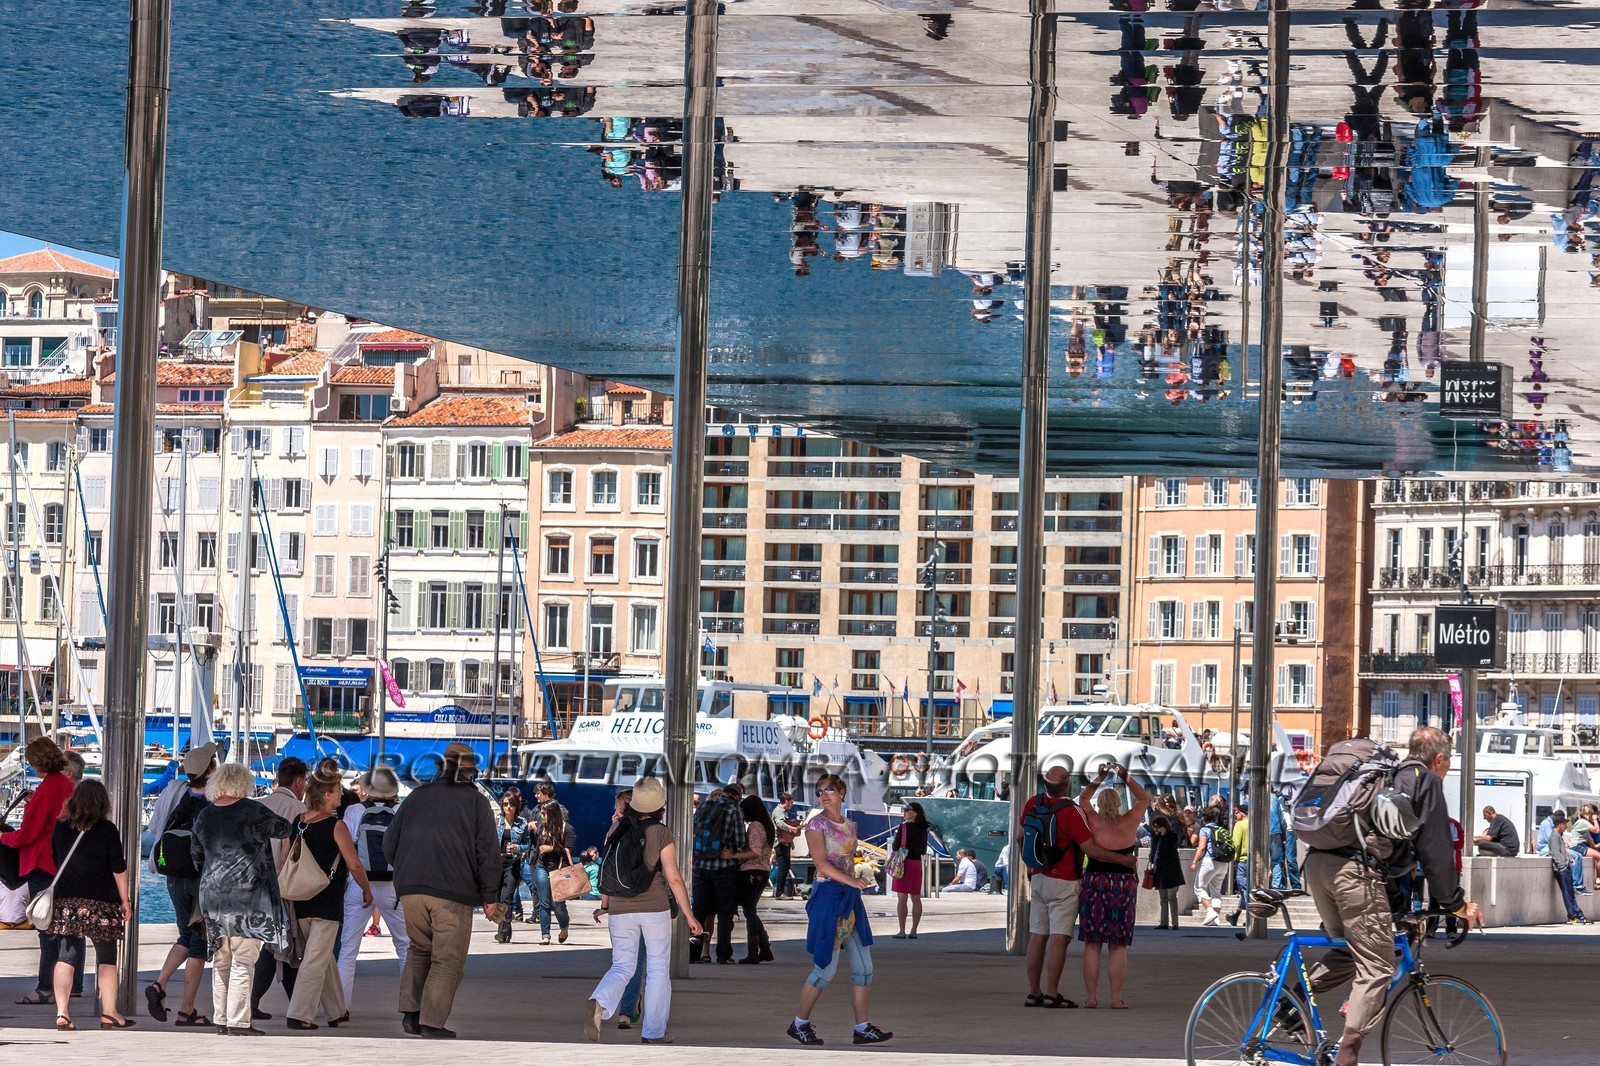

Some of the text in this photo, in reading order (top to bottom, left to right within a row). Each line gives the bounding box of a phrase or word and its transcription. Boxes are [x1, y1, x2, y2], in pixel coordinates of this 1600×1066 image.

[1439, 623, 1490, 645] Métro
[434, 713, 448, 723] CHEZ
[578, 720, 601, 729] ICARD
[611, 717, 665, 734] HELIO
[695, 722, 712, 730] ARD
[741, 724, 779, 745] HELIOS
